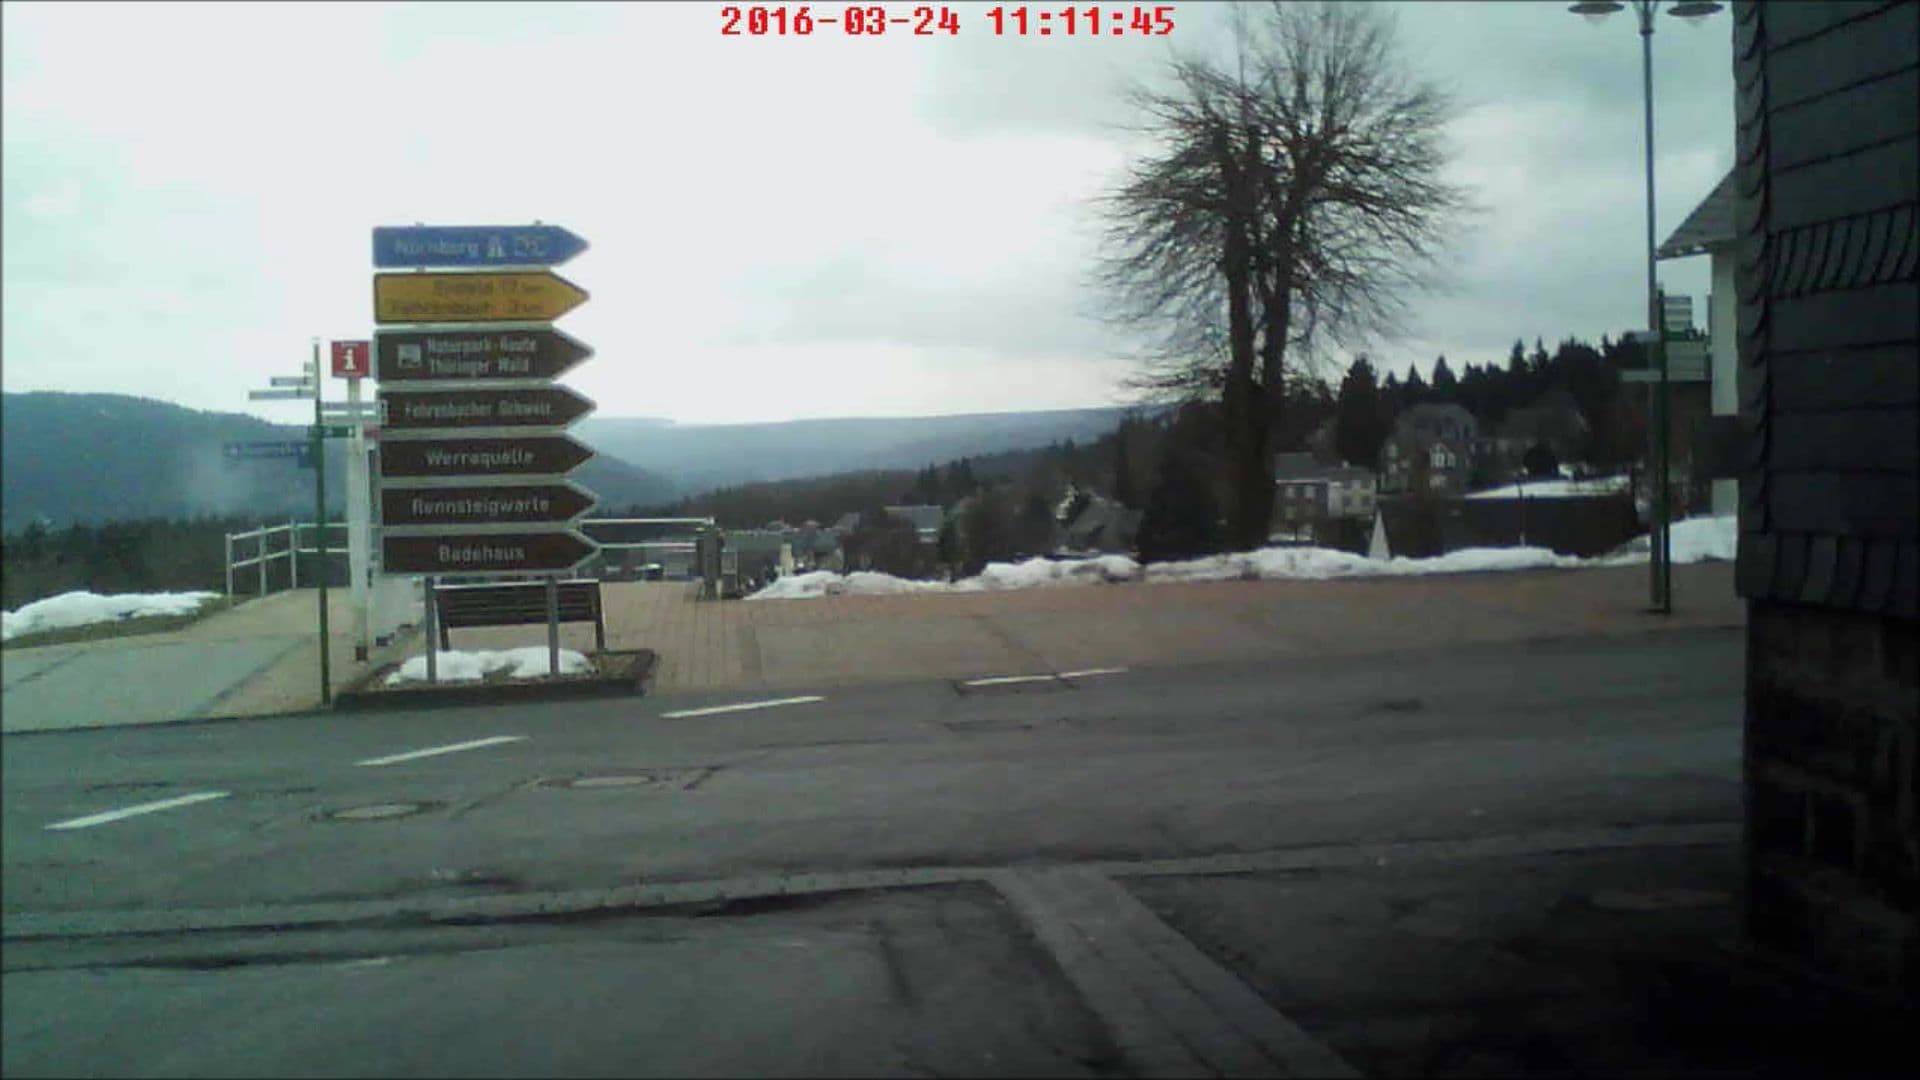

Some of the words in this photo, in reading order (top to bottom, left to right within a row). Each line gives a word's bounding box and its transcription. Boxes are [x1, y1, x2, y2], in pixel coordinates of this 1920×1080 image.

[426, 448, 536, 468] Werraquelle
[412, 496, 550, 517] Rennsteigwarte
[438, 544, 526, 563] Badehaus
